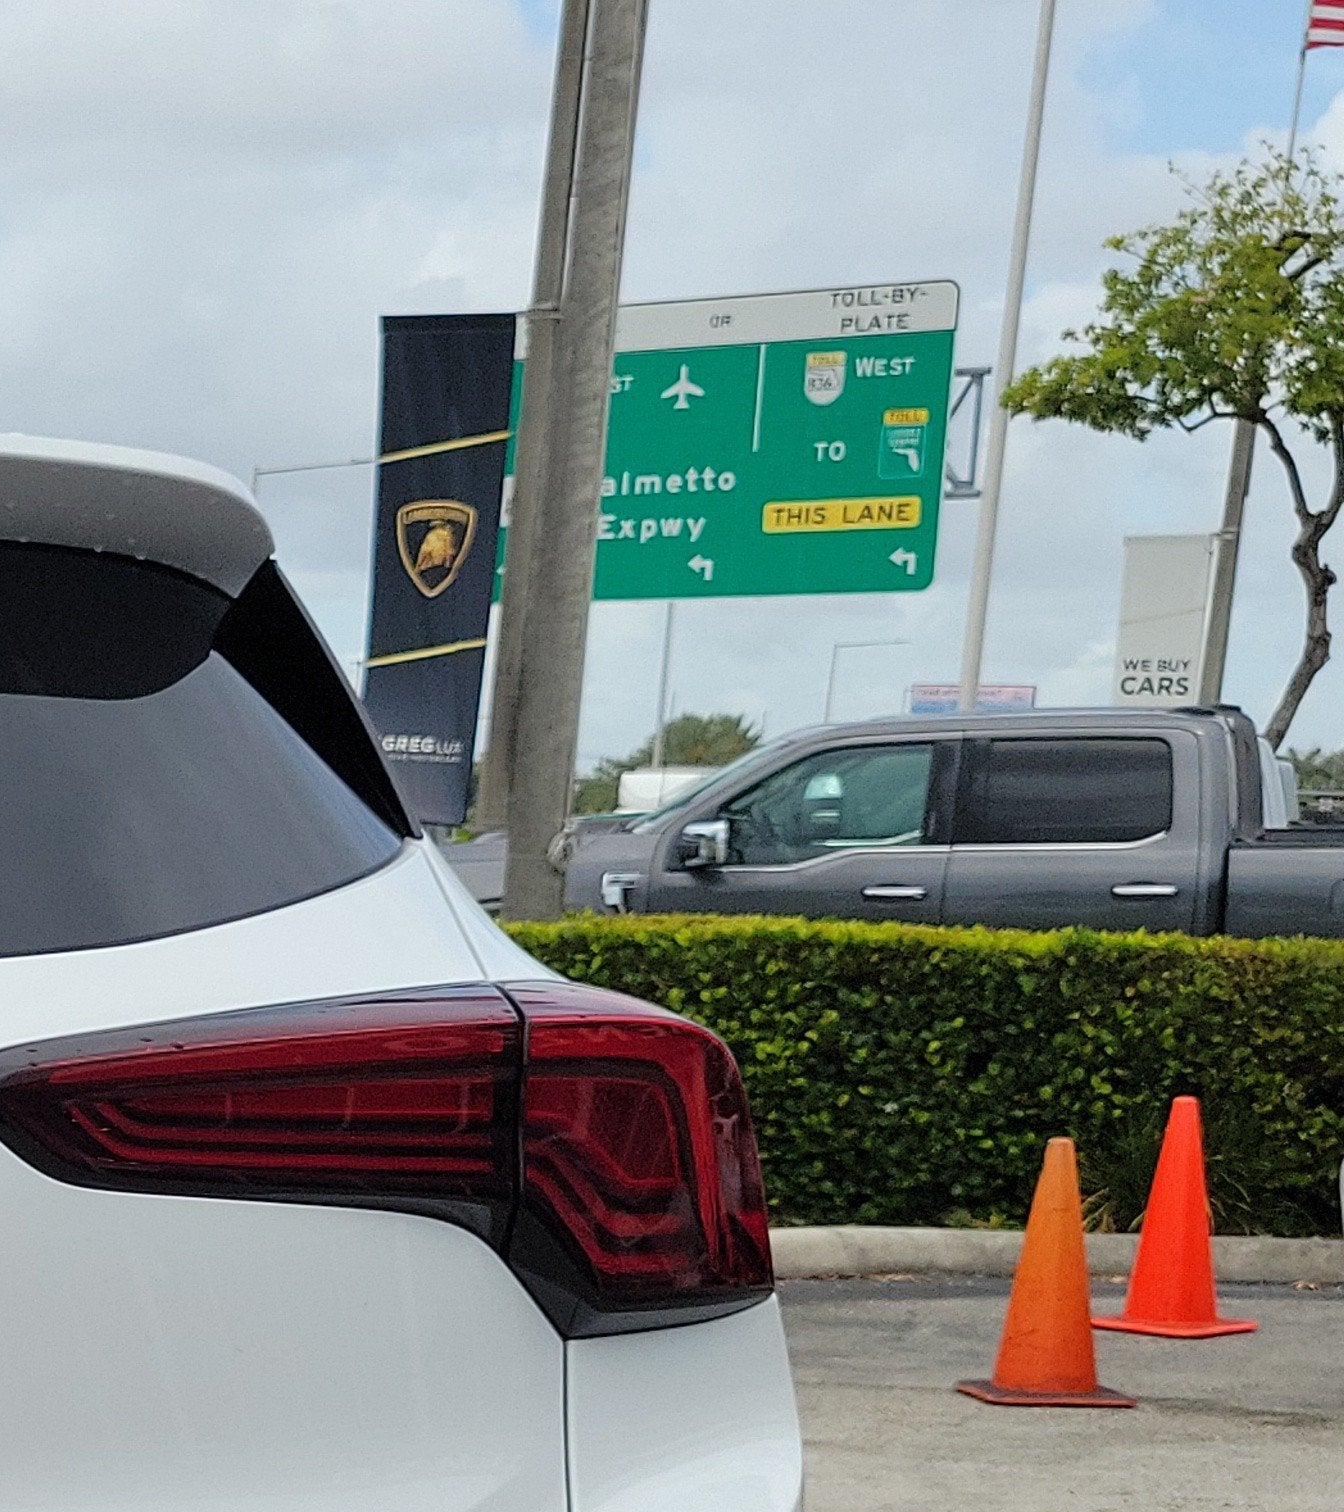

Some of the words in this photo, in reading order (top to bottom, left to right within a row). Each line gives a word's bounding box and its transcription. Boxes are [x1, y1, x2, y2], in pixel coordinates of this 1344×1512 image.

[830, 286, 928, 309] TOLL-BY-
[840, 312, 911, 334] PLATE
[855, 356, 917, 378] WEST
[813, 440, 847, 462] TO
[599, 466, 737, 497] almetto
[773, 505, 827, 527] THIS
[841, 502, 912, 525] LANE
[595, 513, 707, 544] Expwy
[1122, 658, 1153, 673] WE
[1156, 658, 1191, 673] BUY
[1120, 676, 1190, 696] CARS
